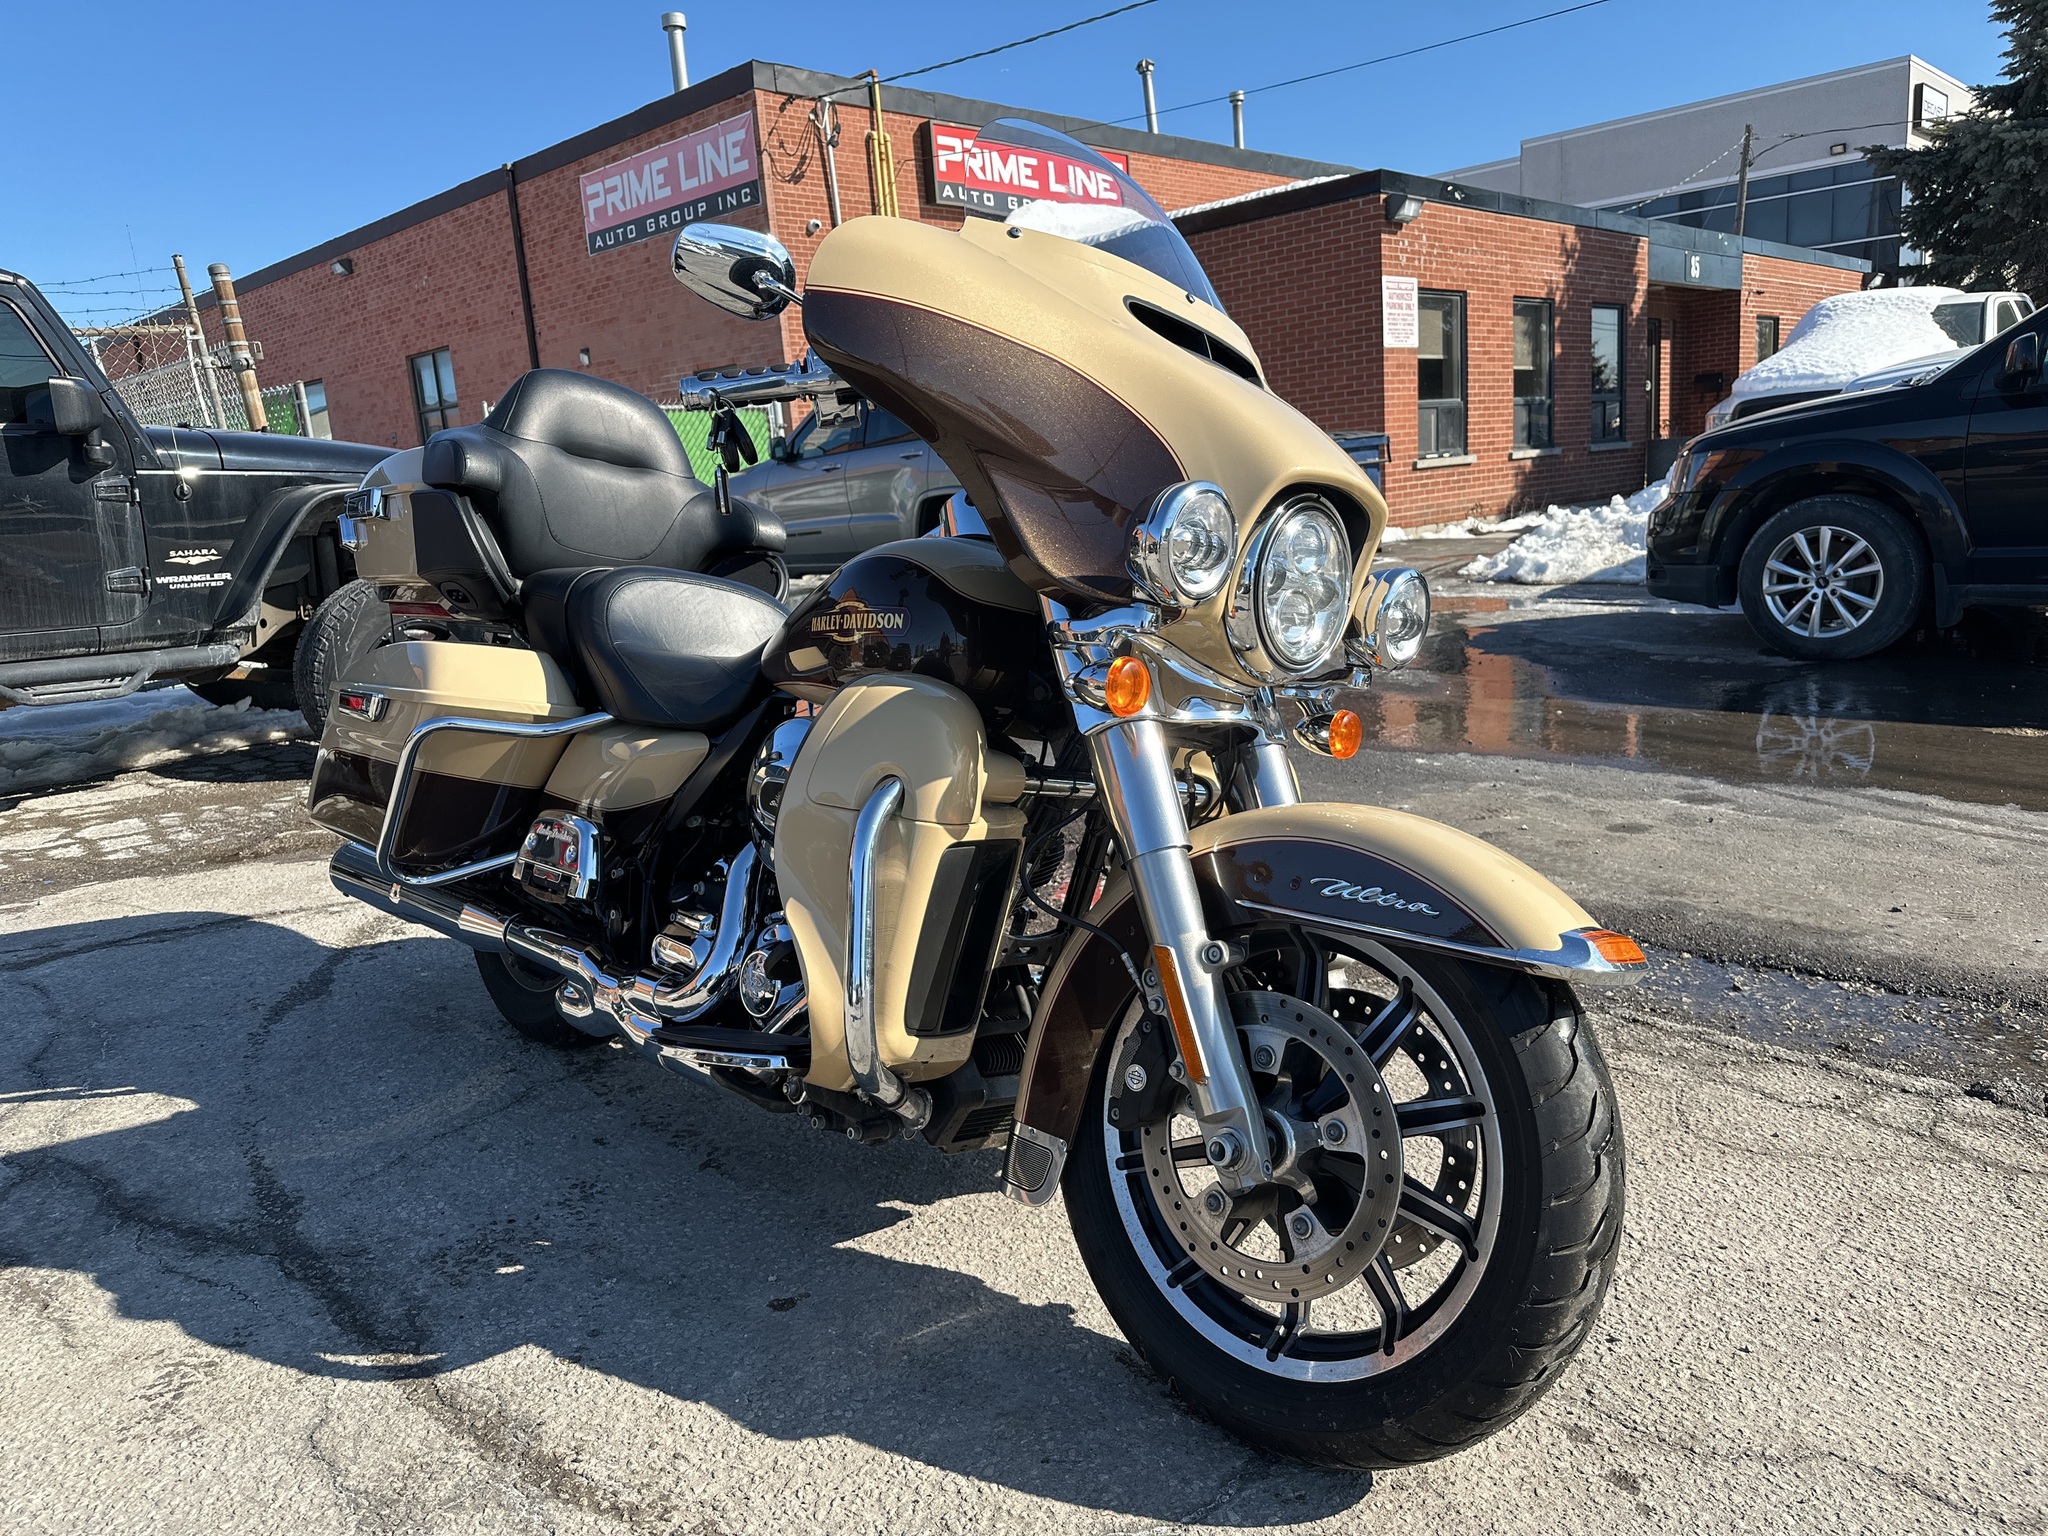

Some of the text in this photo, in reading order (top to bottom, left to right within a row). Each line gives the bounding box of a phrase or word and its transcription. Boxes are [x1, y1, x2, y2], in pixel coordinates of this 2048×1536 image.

[586, 128, 749, 222] PRIME LINE
[936, 135, 1118, 201] PRIME LINE
[942, 184, 995, 207] AUTO
[595, 187, 751, 249] AUTO GROUP INC
[1690, 255, 1700, 278] 85
[169, 548, 218, 557] SAHARA
[155, 572, 232, 584] WRANGLER
[169, 581, 224, 589] UNLIMITED
[1309, 877, 1440, 918] Ultra
